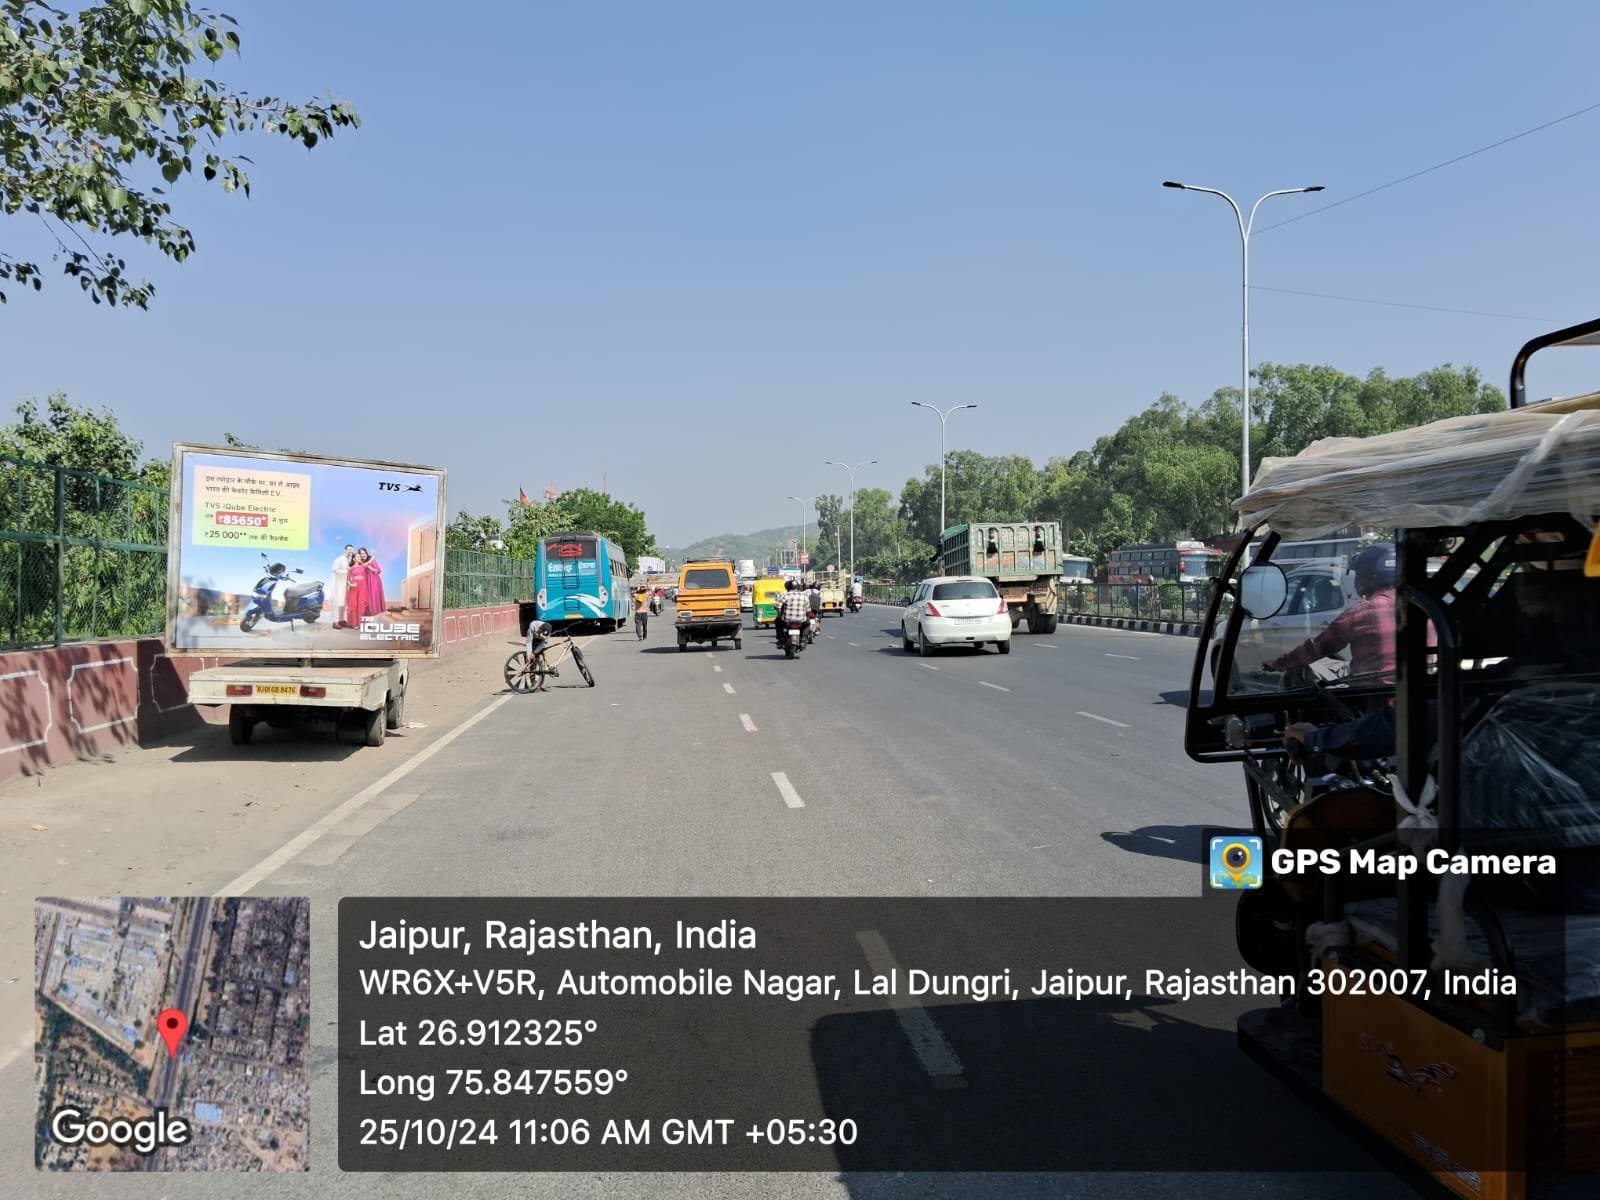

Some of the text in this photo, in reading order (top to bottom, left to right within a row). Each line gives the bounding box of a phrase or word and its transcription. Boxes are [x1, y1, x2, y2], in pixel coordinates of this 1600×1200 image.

[379, 482, 401, 491] TVS
[223, 503, 246, 511] iQube
[360, 633, 420, 641] ELECTRIC
